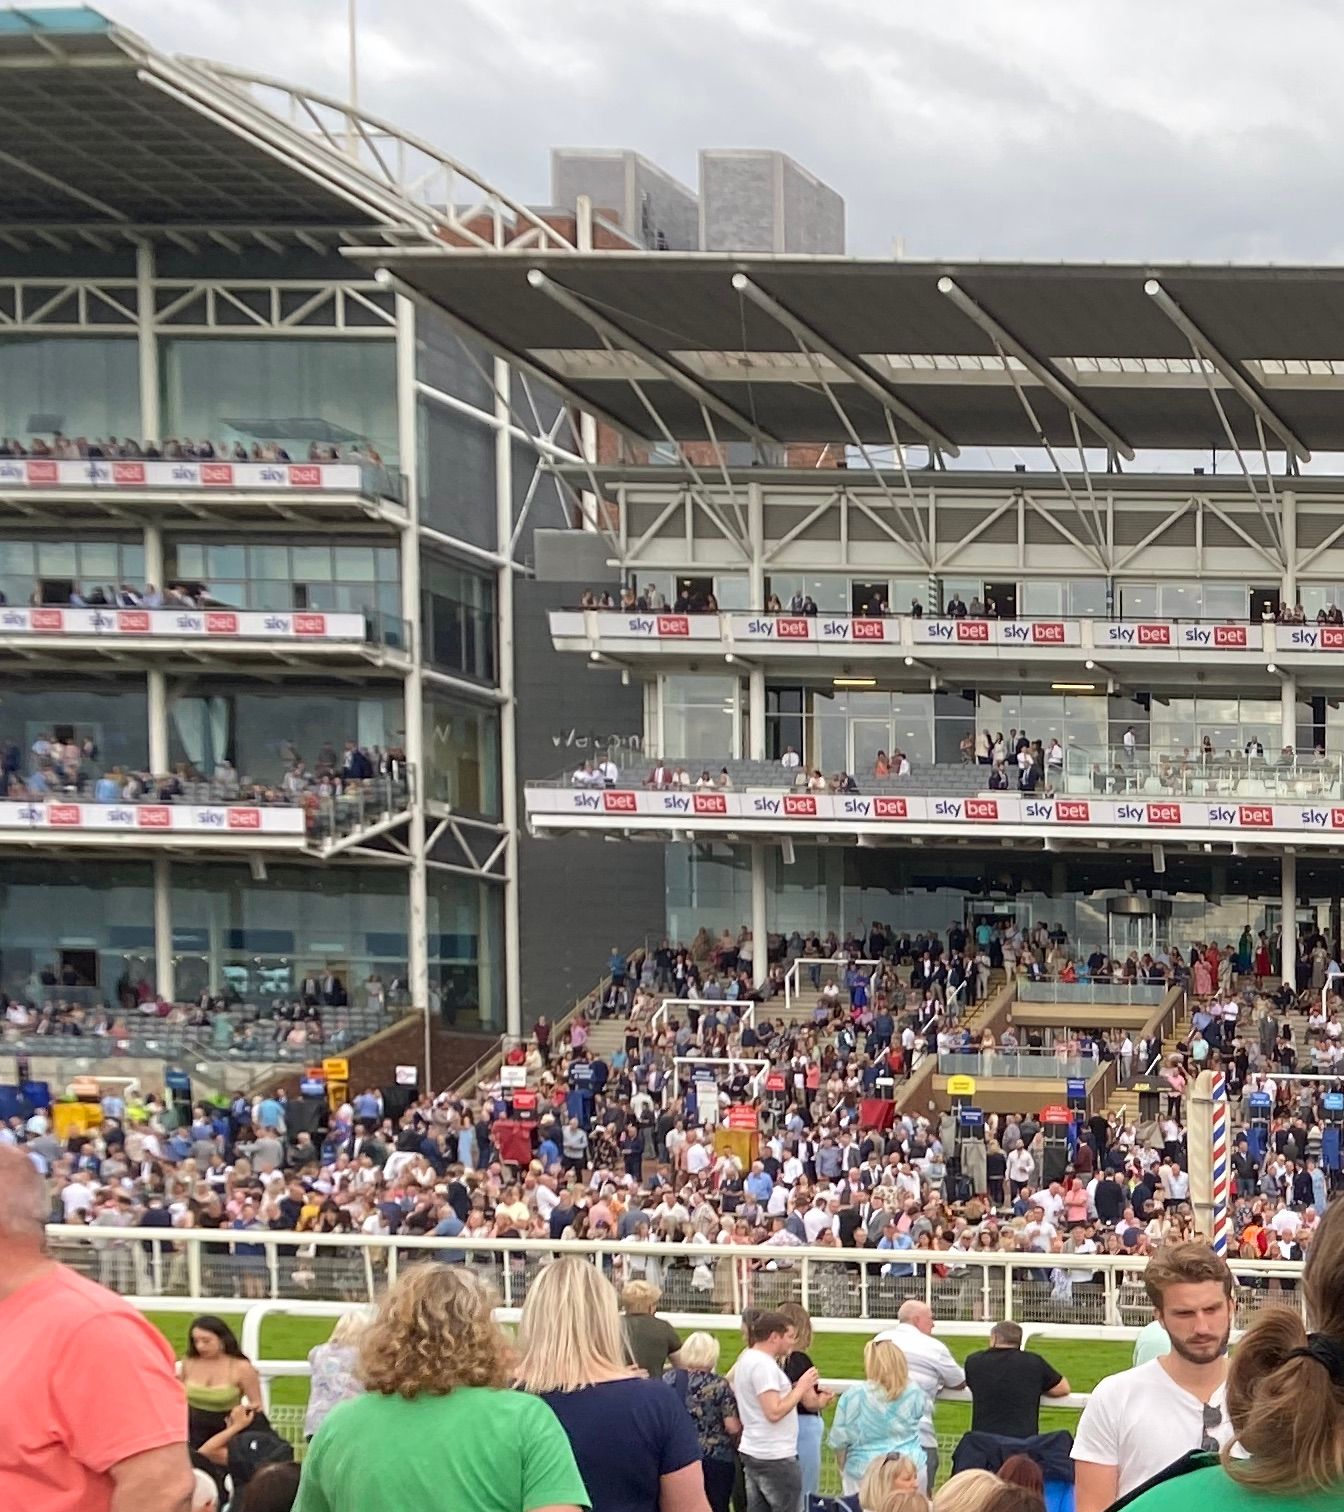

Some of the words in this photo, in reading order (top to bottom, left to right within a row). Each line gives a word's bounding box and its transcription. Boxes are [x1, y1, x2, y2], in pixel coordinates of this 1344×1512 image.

[629, 618, 653, 634] sky
[660, 618, 686, 633] bet
[749, 620, 773, 636] sky
[779, 621, 806, 635] bet
[824, 621, 848, 638] sky
[855, 622, 881, 637] bet
[928, 623, 953, 639] sky
[960, 624, 986, 638] bet
[1004, 625, 1029, 640] sky
[1035, 626, 1062, 639] bet
[1110, 626, 1134, 642] sky
[1140, 627, 1168, 641] bet
[1186, 628, 1211, 644] sky
[1216, 629, 1244, 643] bet
[1292, 630, 1317, 646] sky
[574, 794, 600, 809] sky
[606, 793, 634, 809] bet
[664, 795, 689, 811] sky
[696, 797, 724, 811] bet
[754, 797, 780, 813] sky
[786, 797, 814, 812] bet
[845, 799, 870, 815] sky
[876, 800, 905, 814] bet
[936, 800, 961, 817] sky
[967, 802, 995, 816] bet
[1027, 803, 1052, 819] sky
[1058, 804, 1087, 818] bet
[1118, 805, 1143, 822] sky
[1150, 805, 1178, 820] bet
[1210, 807, 1236, 824] sky
[1241, 808, 1270, 823] bet
[1302, 809, 1328, 826] sky
